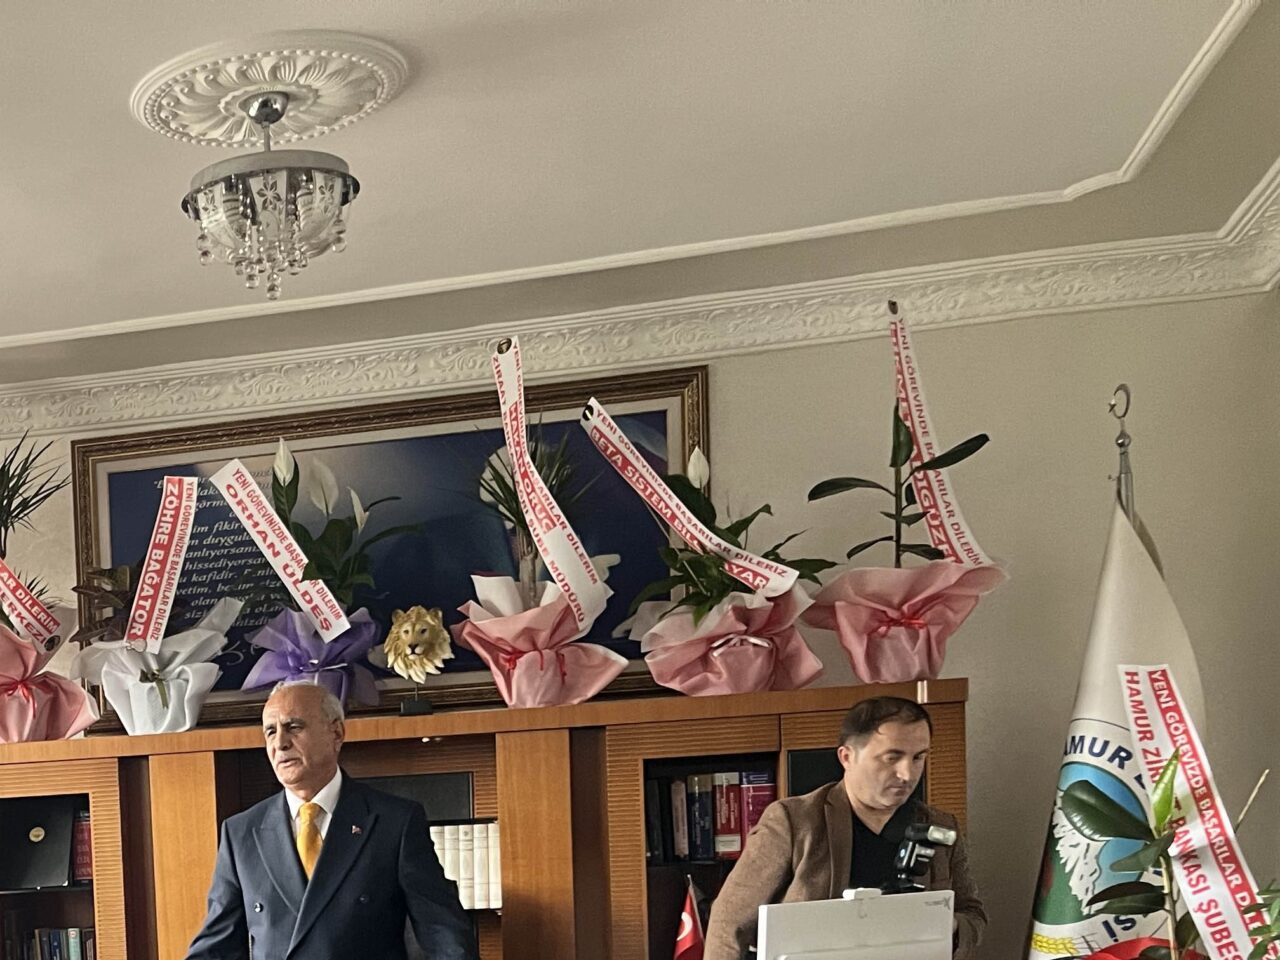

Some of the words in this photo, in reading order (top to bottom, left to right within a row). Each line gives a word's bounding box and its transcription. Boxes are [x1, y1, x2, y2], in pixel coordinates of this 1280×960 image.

[509, 402, 526, 473] HAKAN
[591, 430, 623, 467] BETA
[624, 466, 674, 519] SİSTEM
[154, 482, 179, 545] ZÖHRE
[493, 356, 506, 405] ZİRAAT
[549, 560, 585, 623] MÜDÜRÜ
[925, 441, 955, 519] BAARILAR
[172, 504, 193, 559] GÖREVİNİZDE
[225, 484, 281, 558] ORHAN
[282, 563, 332, 631] ÜLDEŞ
[232, 468, 253, 490] YENİ
[246, 488, 289, 544] GÖREVİNİZDE
[316, 587, 343, 620] DİLERİM
[566, 532, 599, 585] DİLERİM
[734, 552, 788, 578] DİLERİZ
[15, 587, 60, 633] DİLERİM
[130, 548, 165, 636] BAĞATOR
[159, 561, 180, 608] BAŞARILAR
[151, 607, 167, 641] DİLERİZ
[1124, 671, 1155, 742] HAMUR
[1167, 818, 1212, 896] BANKASI
[1150, 671, 1176, 709] YENİ
[1165, 711, 1208, 798] GÖREVİZDE
[1199, 799, 1242, 888] BAŞARILAR
